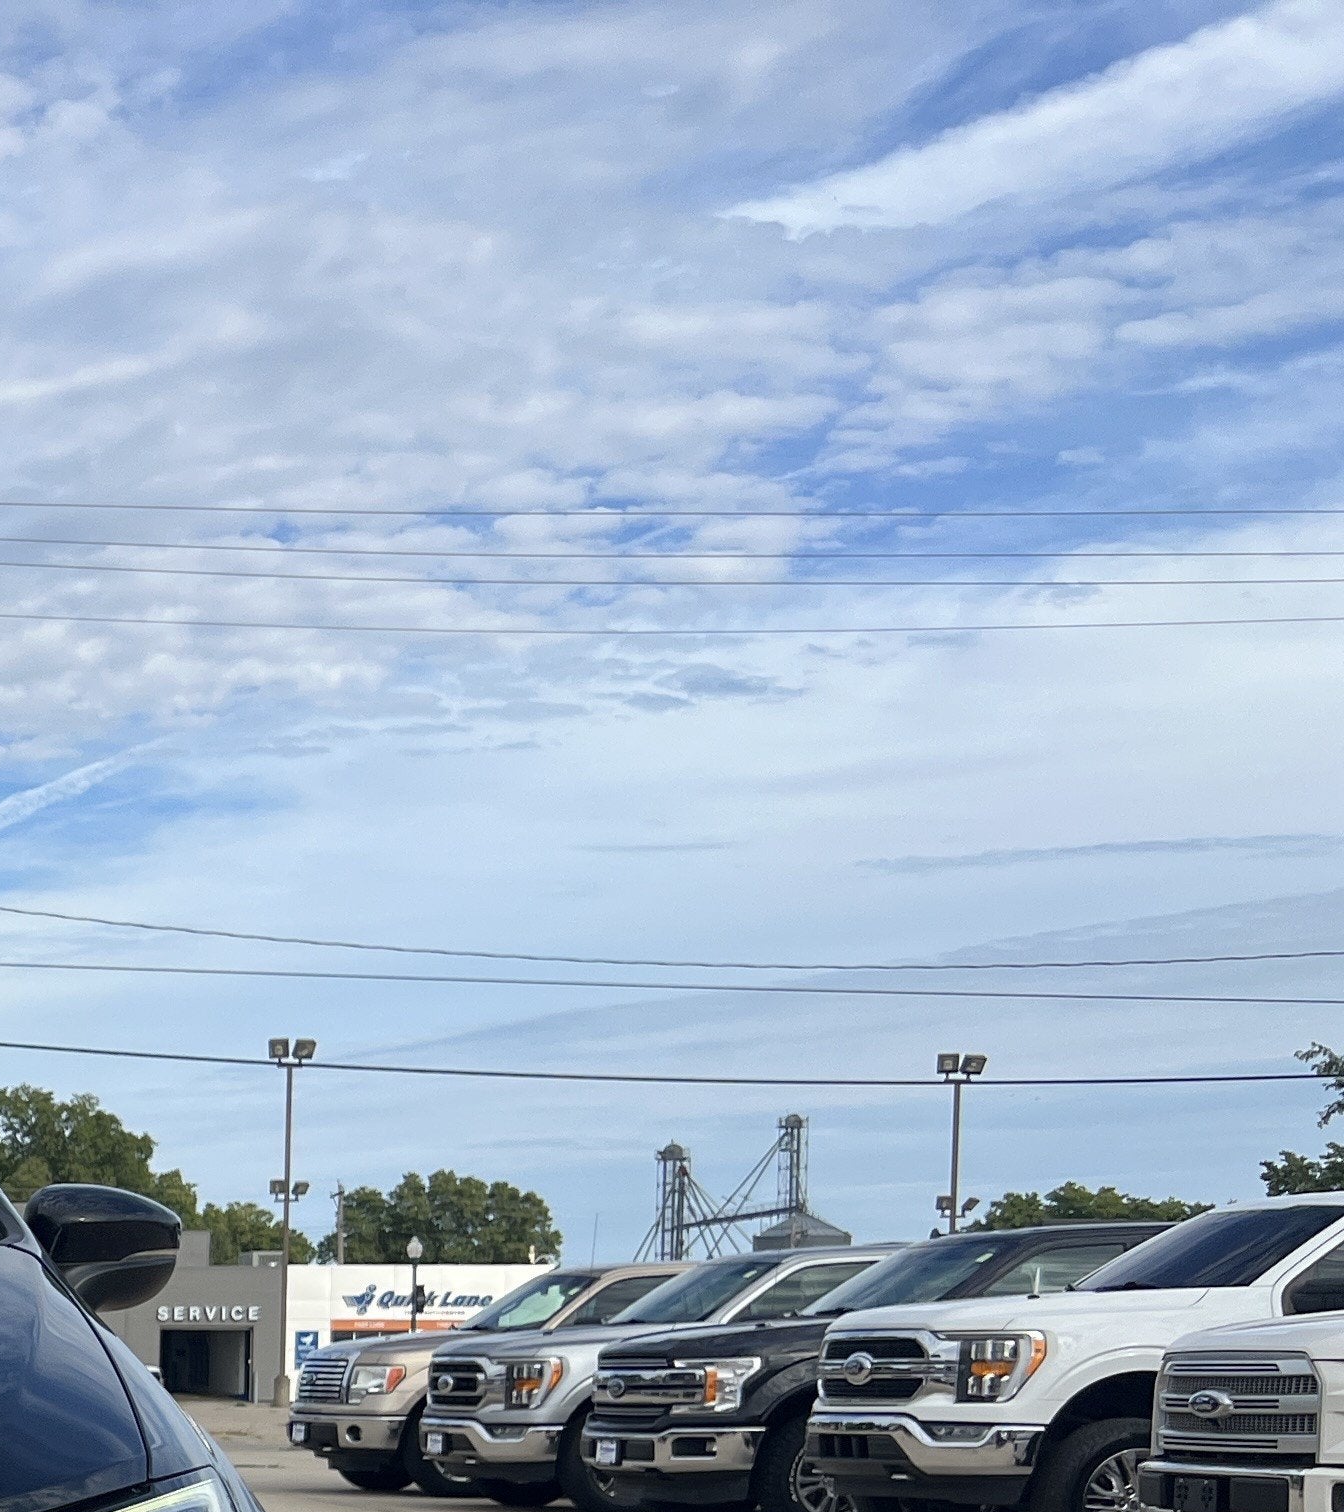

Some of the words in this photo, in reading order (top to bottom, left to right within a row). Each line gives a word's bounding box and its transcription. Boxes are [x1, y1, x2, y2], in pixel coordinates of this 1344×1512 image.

[378, 1291, 435, 1308] Quik
[439, 1291, 493, 1307] Lane
[156, 1306, 261, 1322] SERVICE
